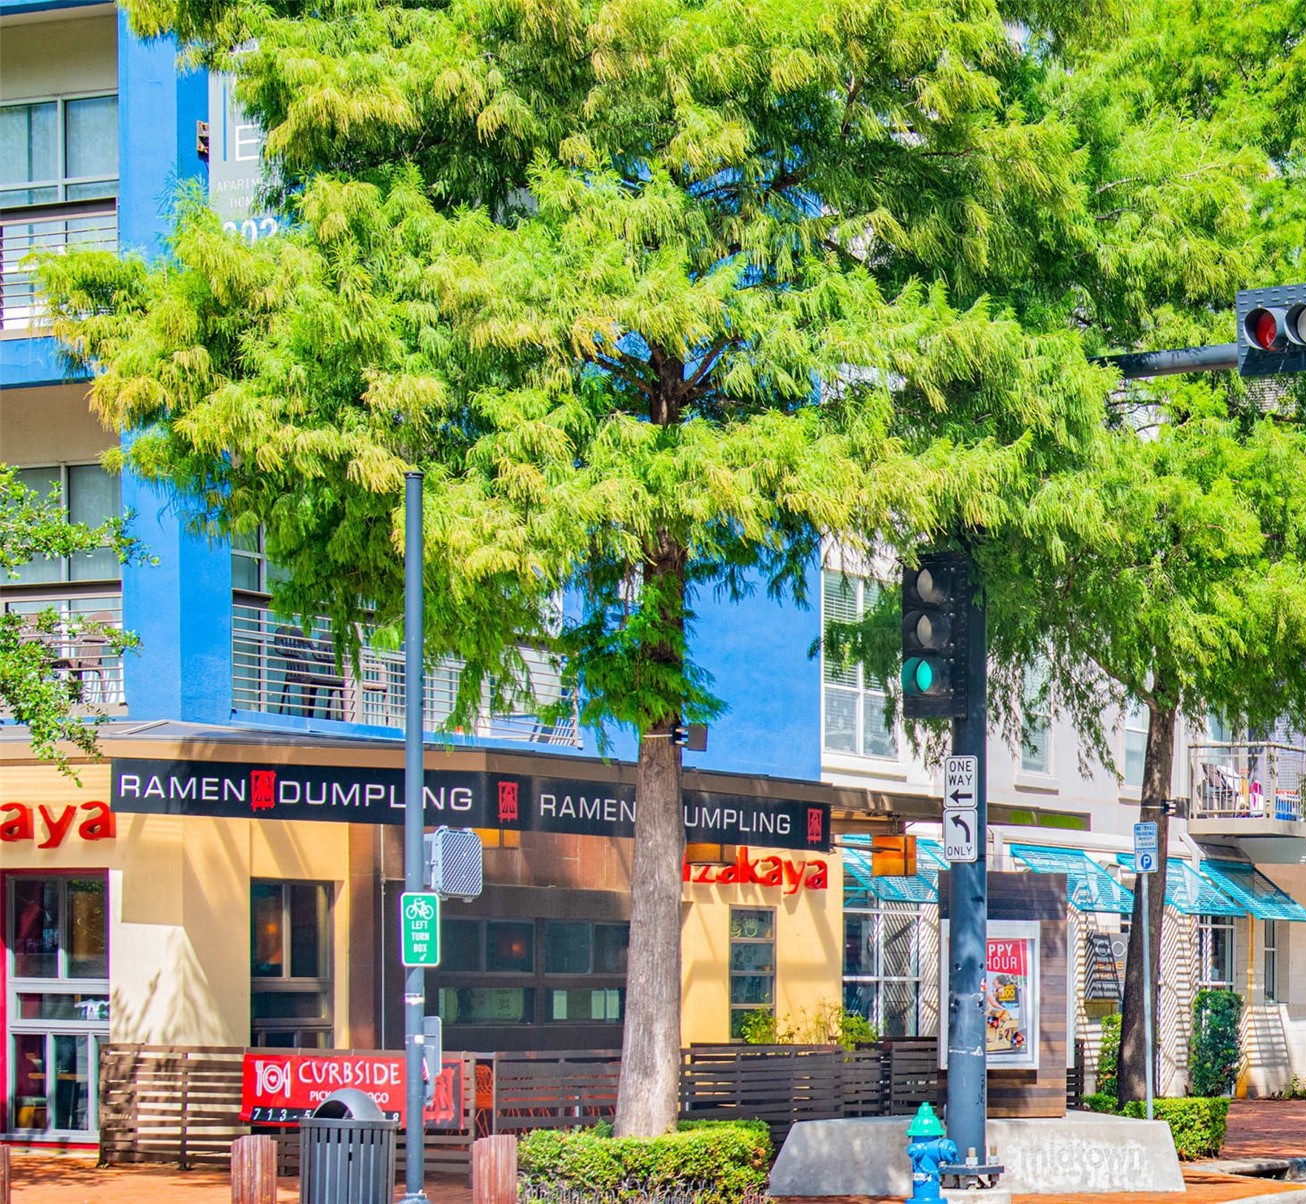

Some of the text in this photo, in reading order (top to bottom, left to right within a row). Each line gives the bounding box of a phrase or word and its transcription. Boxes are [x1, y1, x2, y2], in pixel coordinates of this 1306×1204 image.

[949, 760, 972, 773] ONE
[948, 775, 973, 786] WAY
[120, 775, 246, 801] RAMEN
[279, 780, 473, 811] DUMPLNG
[540, 794, 636, 823] RAMEN
[683, 805, 791, 835] UMPLING
[947, 846, 972, 856] ONLY
[411, 920, 428, 930] LEFT
[411, 932, 430, 941] TURN
[413, 943, 427, 952] BOX
[988, 943, 1013, 957] PPY
[299, 1060, 401, 1085] CURBSIDE
